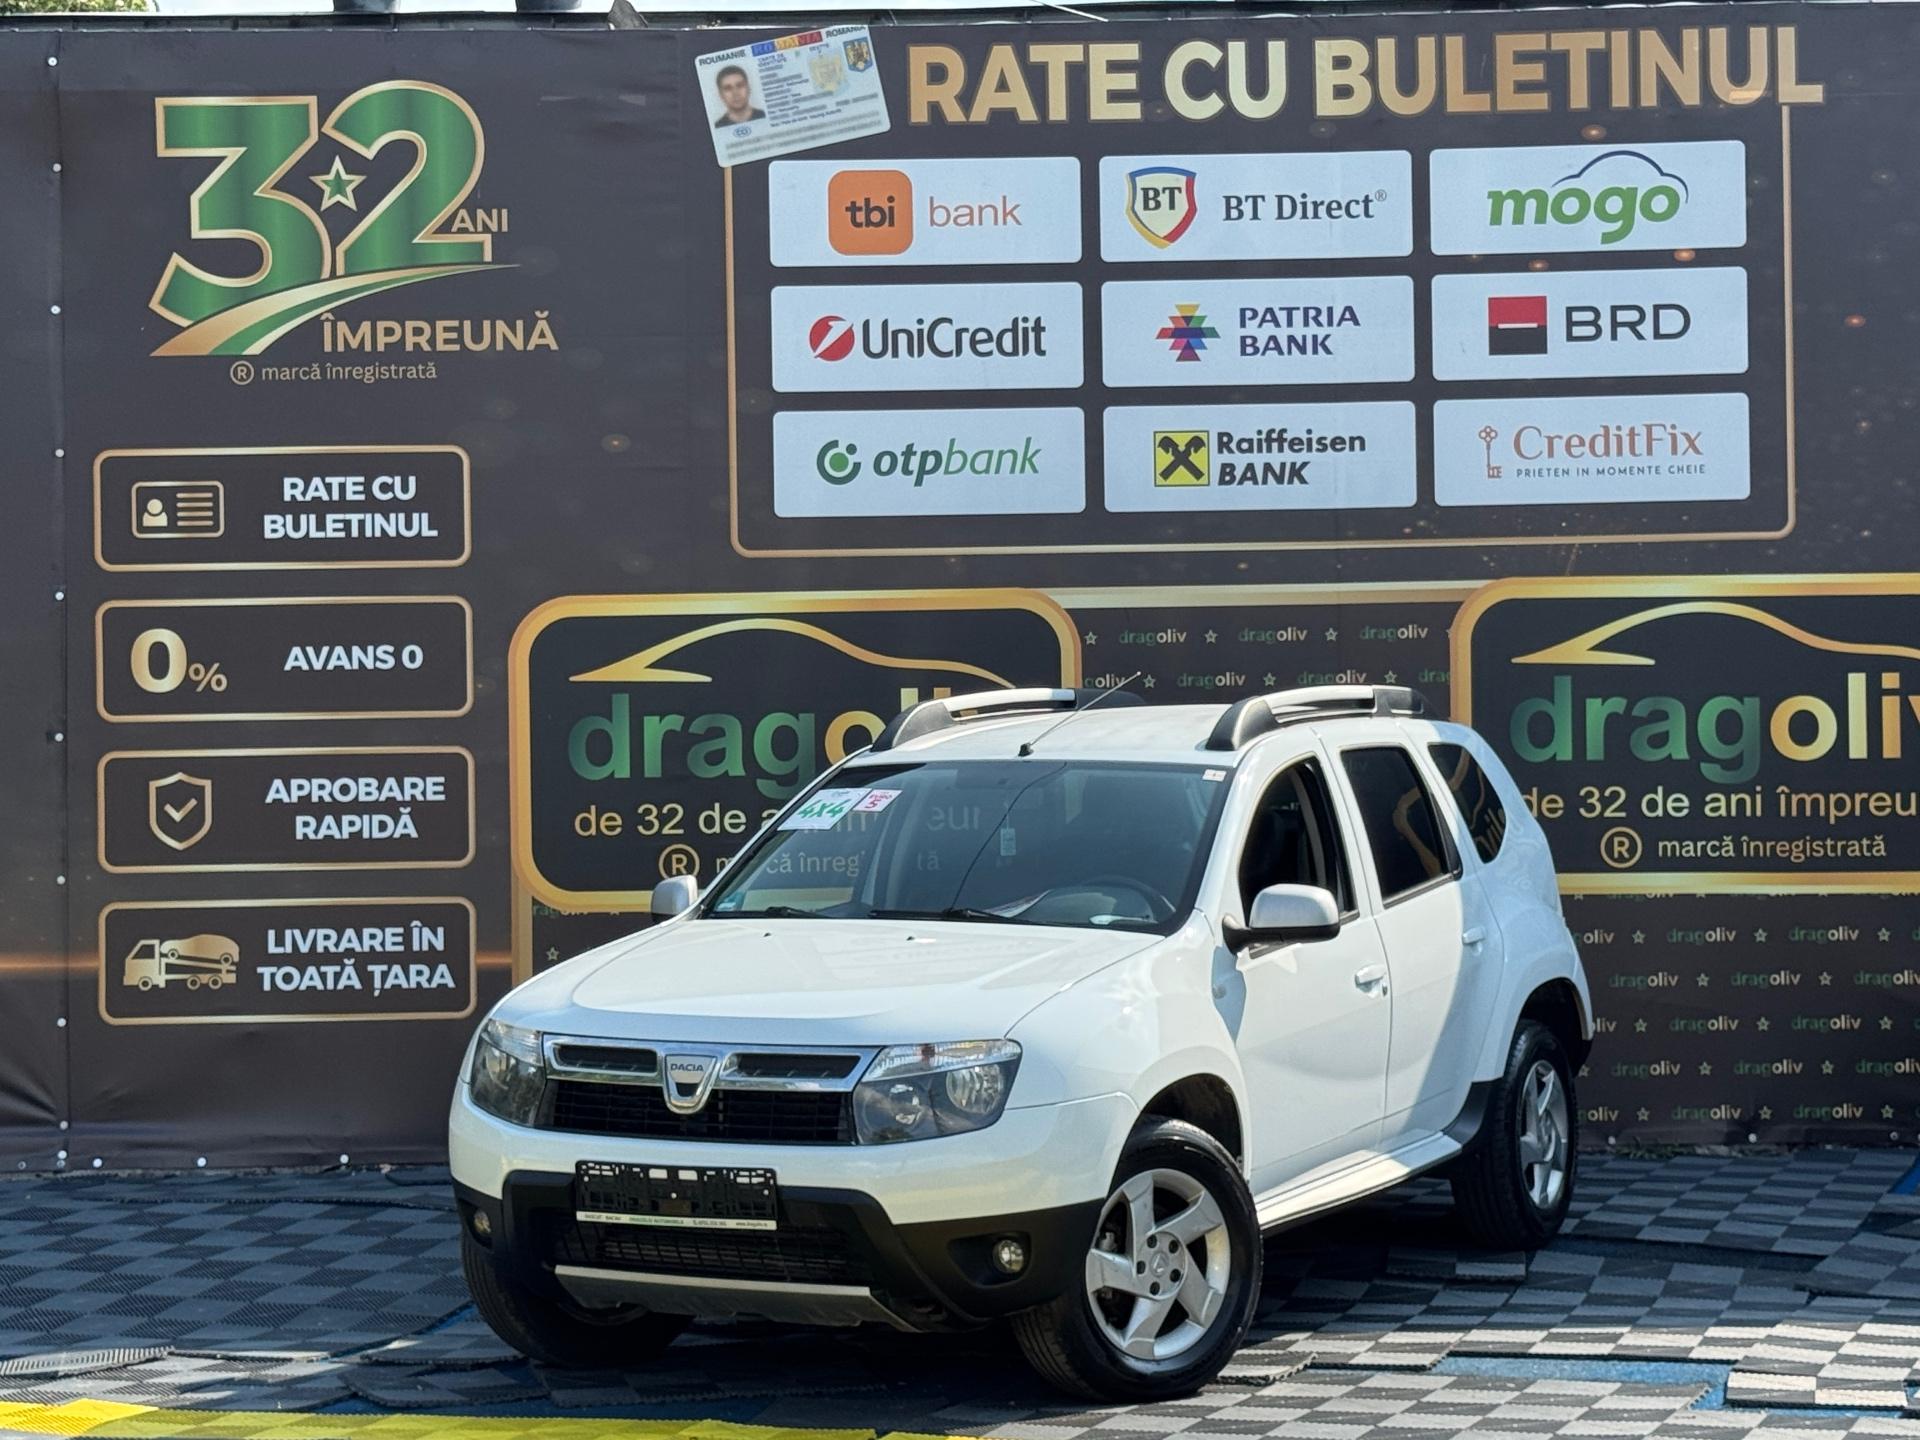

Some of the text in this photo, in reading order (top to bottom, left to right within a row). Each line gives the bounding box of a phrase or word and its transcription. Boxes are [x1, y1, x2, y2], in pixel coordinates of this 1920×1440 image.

[907, 26, 1824, 123] RATE CU BULETINUL
[149, 79, 509, 327] 32 ANI
[845, 195, 1022, 228] tbi bank
[1140, 186, 1182, 212] BT
[1222, 195, 1265, 222] BT
[1487, 185, 1681, 245] mogo
[1239, 305, 1361, 329] PATRIA
[1565, 303, 1691, 342] BRD
[320, 311, 559, 353] ÎMPREUNĂ
[862, 315, 1046, 359] UniCredit
[1239, 334, 1334, 357] BANK
[261, 360, 321, 381] marcă
[326, 360, 438, 385] înregistrată
[1217, 428, 1366, 455] Raiffeisen
[1513, 423, 1704, 461] CreditFix
[873, 437, 1042, 487] otpbank
[1218, 461, 1311, 486] BANK
[1516, 464, 1706, 478] PRIETEN IN MOMENTE CHEIE
[283, 475, 416, 502] RATE CU
[264, 512, 438, 539] BULETINUL
[1119, 628, 1187, 645] dragoliv
[1238, 626, 1307, 643] dragoliv
[1360, 624, 1428, 641] dragoliv
[131, 628, 228, 694] 0%
[284, 644, 424, 671] AVANS 0
[1177, 672, 1246, 689] dragoliv
[1510, 671, 1920, 784] dragoli
[568, 688, 952, 799] drago
[265, 776, 446, 803] APROBARE
[1579, 786, 1627, 818] 32
[1641, 785, 1690, 817] de
[1704, 785, 1763, 817] ani
[295, 807, 418, 840] RAPIDĂ
[575, 804, 622, 836] de
[637, 803, 685, 835] 32
[699, 802, 747, 834] de
[1658, 834, 1735, 857] marcă
[1741, 834, 1887, 862] înregistrată
[267, 920, 445, 954] LIVRARE ÎN
[1667, 927, 1736, 944] dragoliv
[1788, 926, 1859, 943] dragoliv
[257, 958, 362, 992] TOATĂ
[1608, 972, 1679, 989] dragoliv
[1731, 970, 1801, 988] dragoliv
[1669, 1016, 1739, 1033] dragoliv
[1791, 1014, 1862, 1031] dragoliv
[670, 1063, 705, 1072] DACIA
[1611, 1060, 1681, 1078] dragoliv
[1733, 1059, 1803, 1076] dragoliv
[1671, 1105, 1742, 1122] dragoliv
[1793, 1103, 1863, 1120] dragoliv
